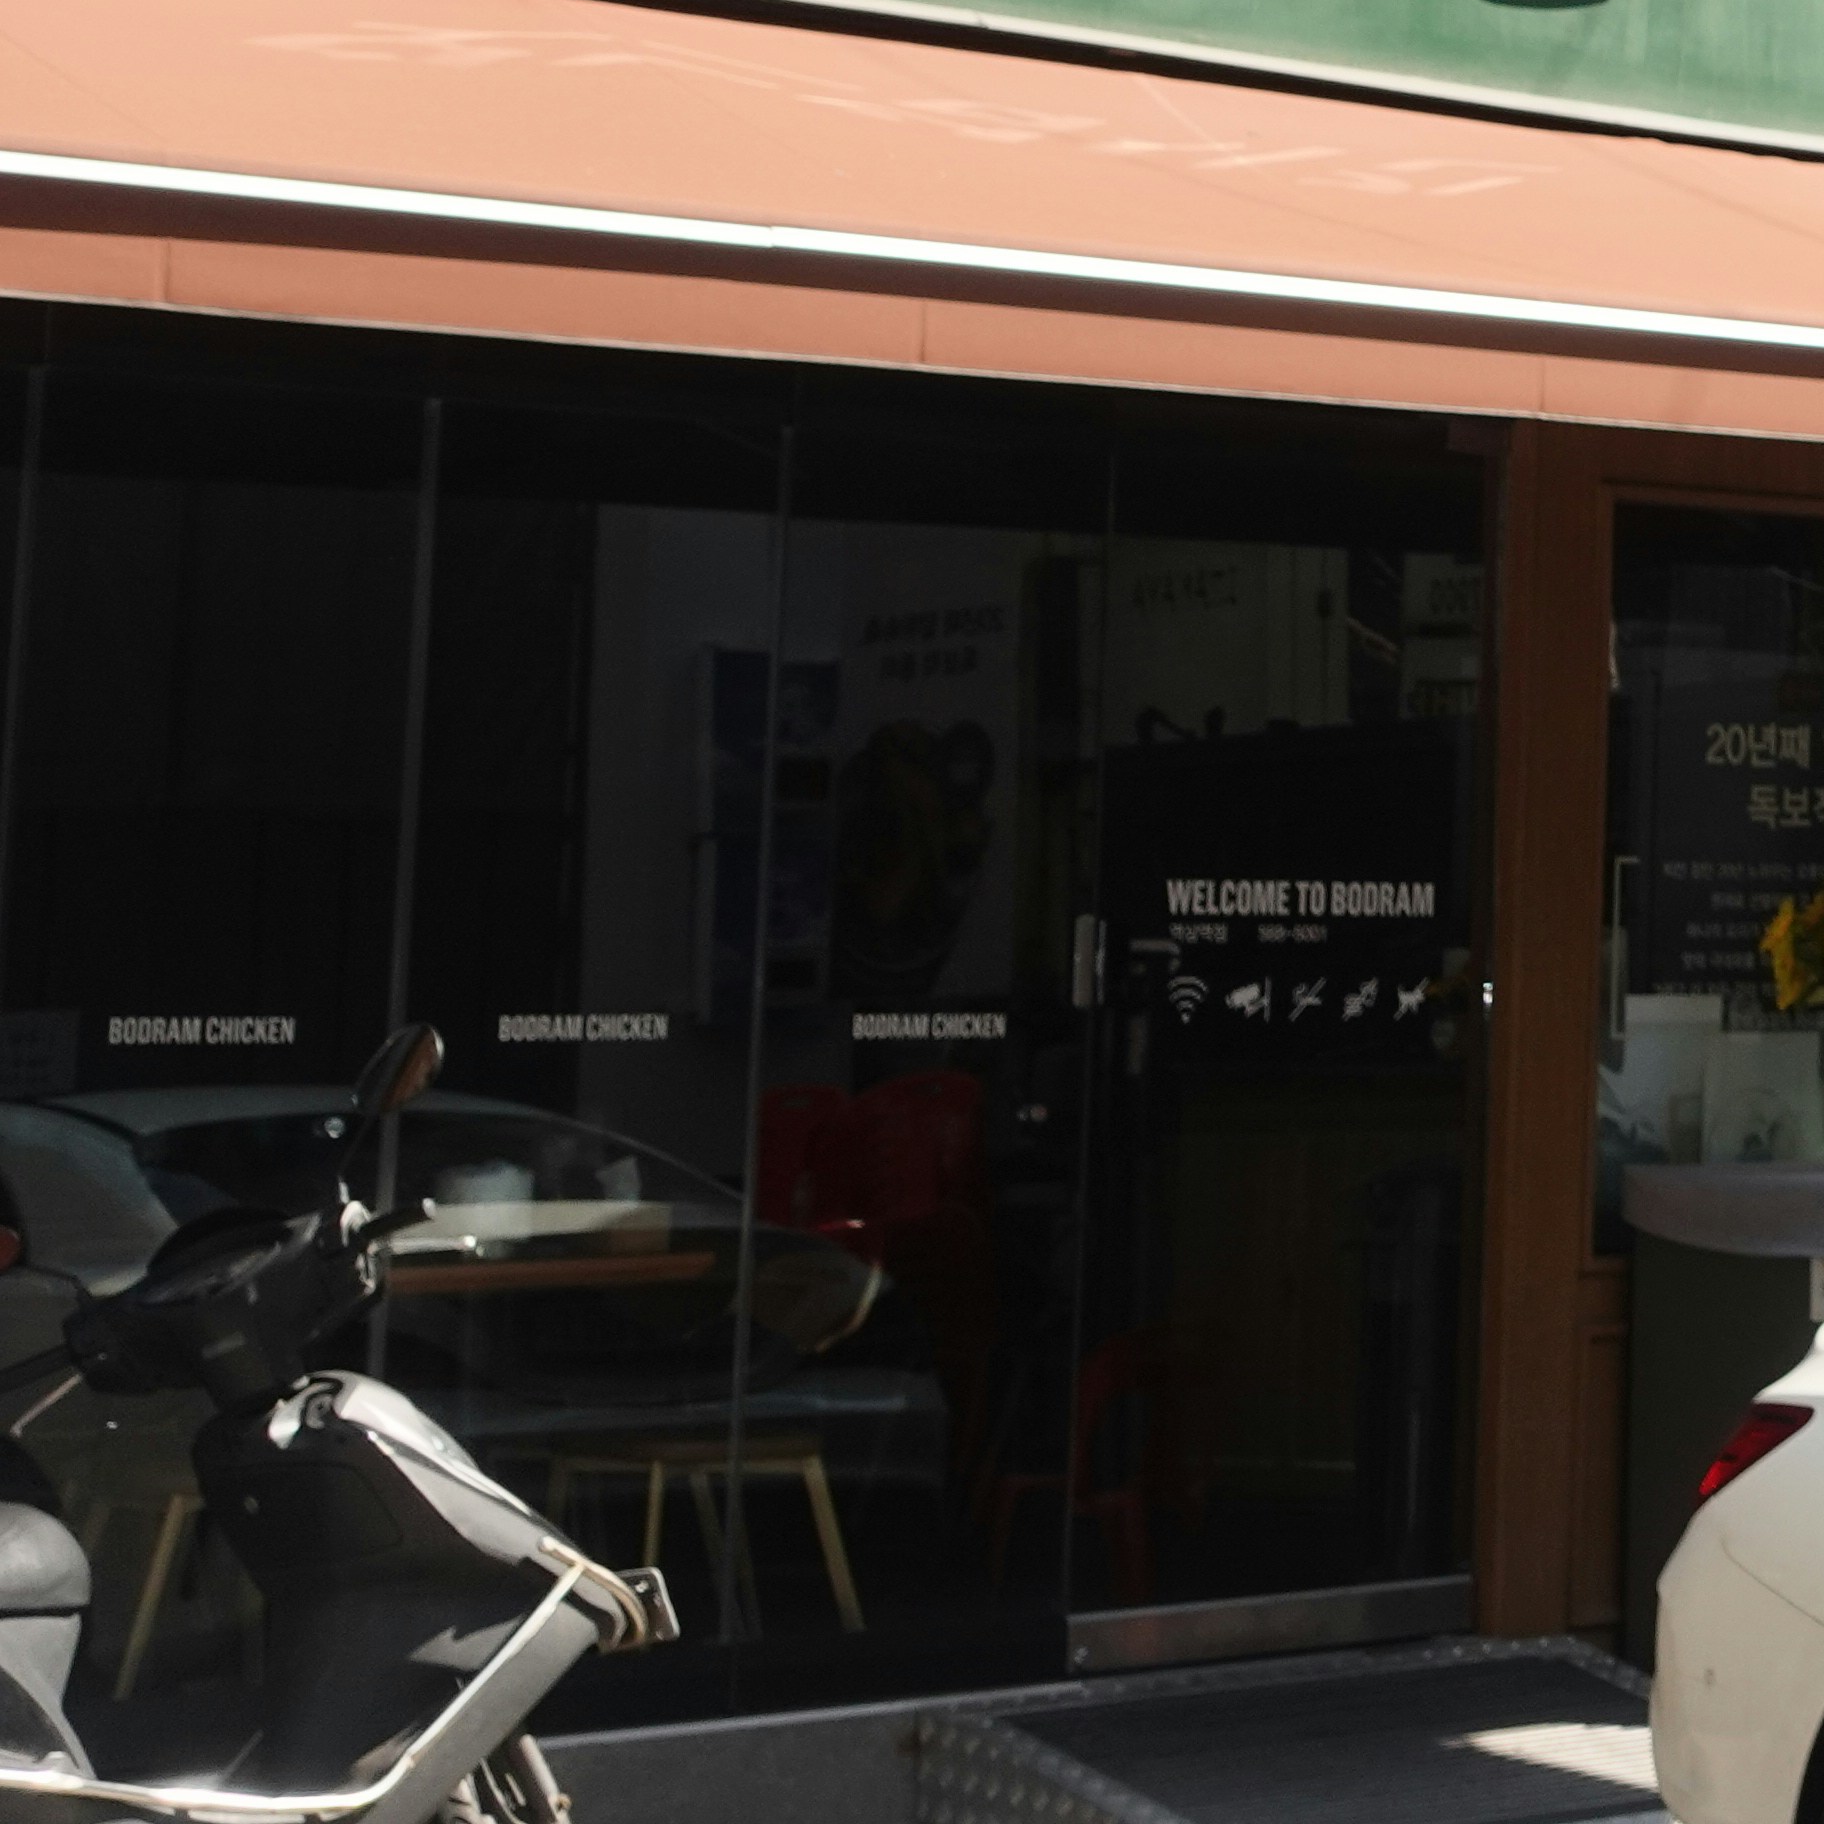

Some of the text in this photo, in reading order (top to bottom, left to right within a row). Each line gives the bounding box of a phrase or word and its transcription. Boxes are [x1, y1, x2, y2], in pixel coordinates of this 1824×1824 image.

[1704, 721, 1811, 770] 20년째
[1166, 878, 1436, 917] WELCOME TO BODRAM
[108, 1016, 296, 1046] BODRAM CHICKEN
[497, 1012, 669, 1043] BODRAM CHICKEN
[851, 1011, 1007, 1040] BODRAM CHICKEN
